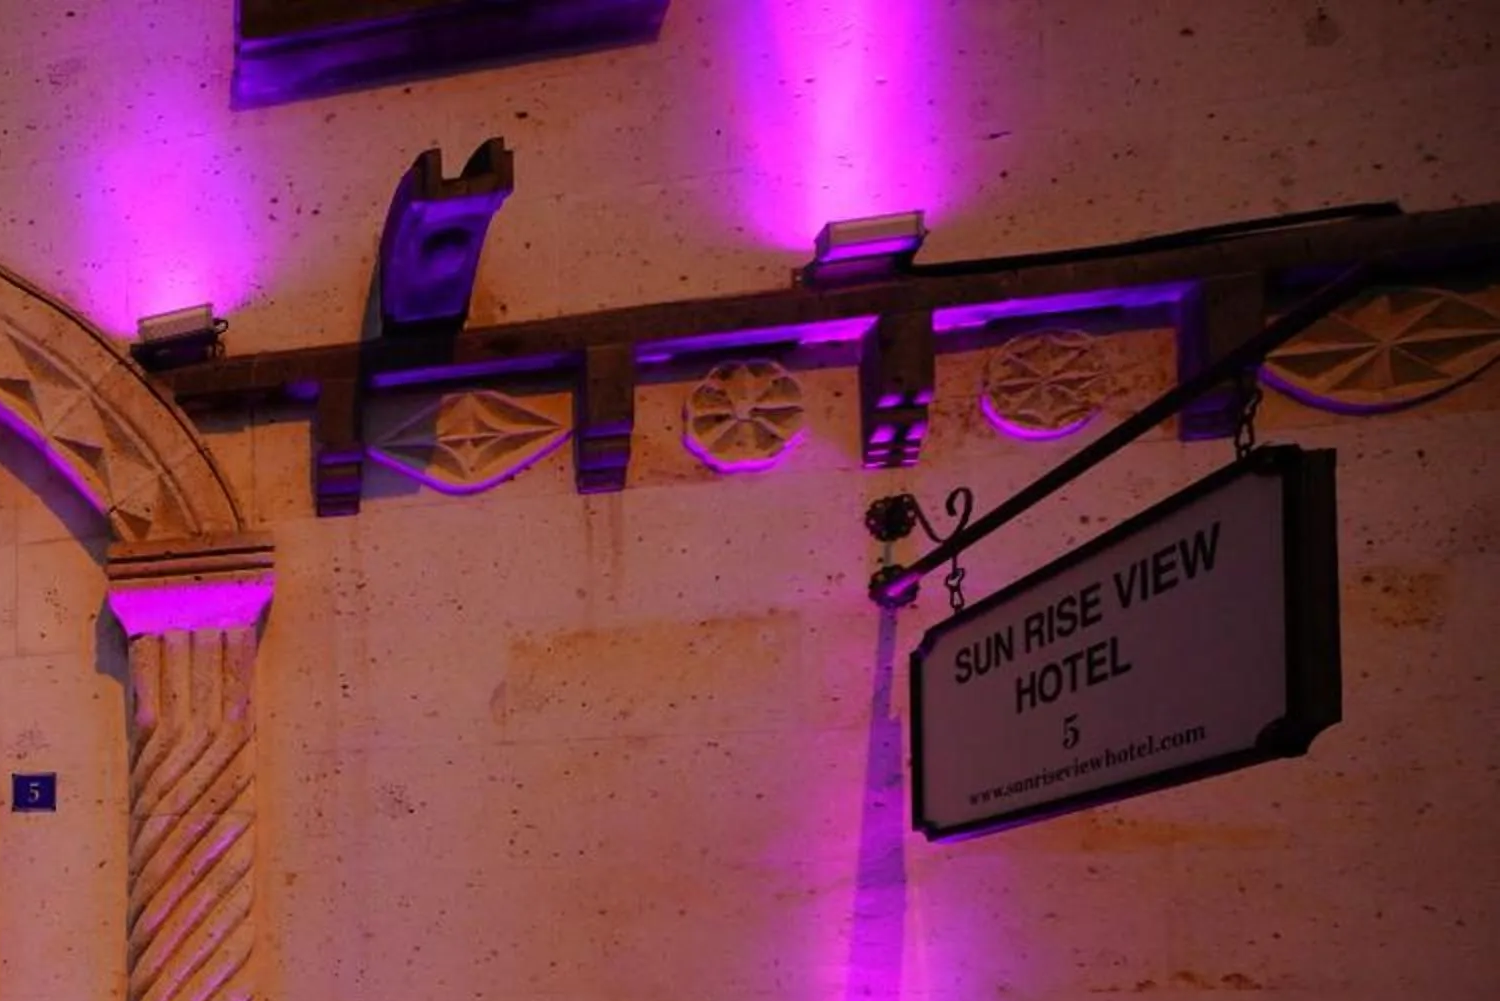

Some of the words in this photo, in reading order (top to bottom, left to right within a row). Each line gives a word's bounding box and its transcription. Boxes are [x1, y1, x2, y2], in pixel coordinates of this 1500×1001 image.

[955, 626, 1014, 684] SUN
[1024, 582, 1102, 652] RISE
[1113, 521, 1221, 610] VIEW
[1014, 637, 1132, 713] HOTEL
[968, 722, 1206, 807] www.sunriseviewhotel.com
[1062, 714, 1080, 749] 5
[27, 782, 41, 803] 5
